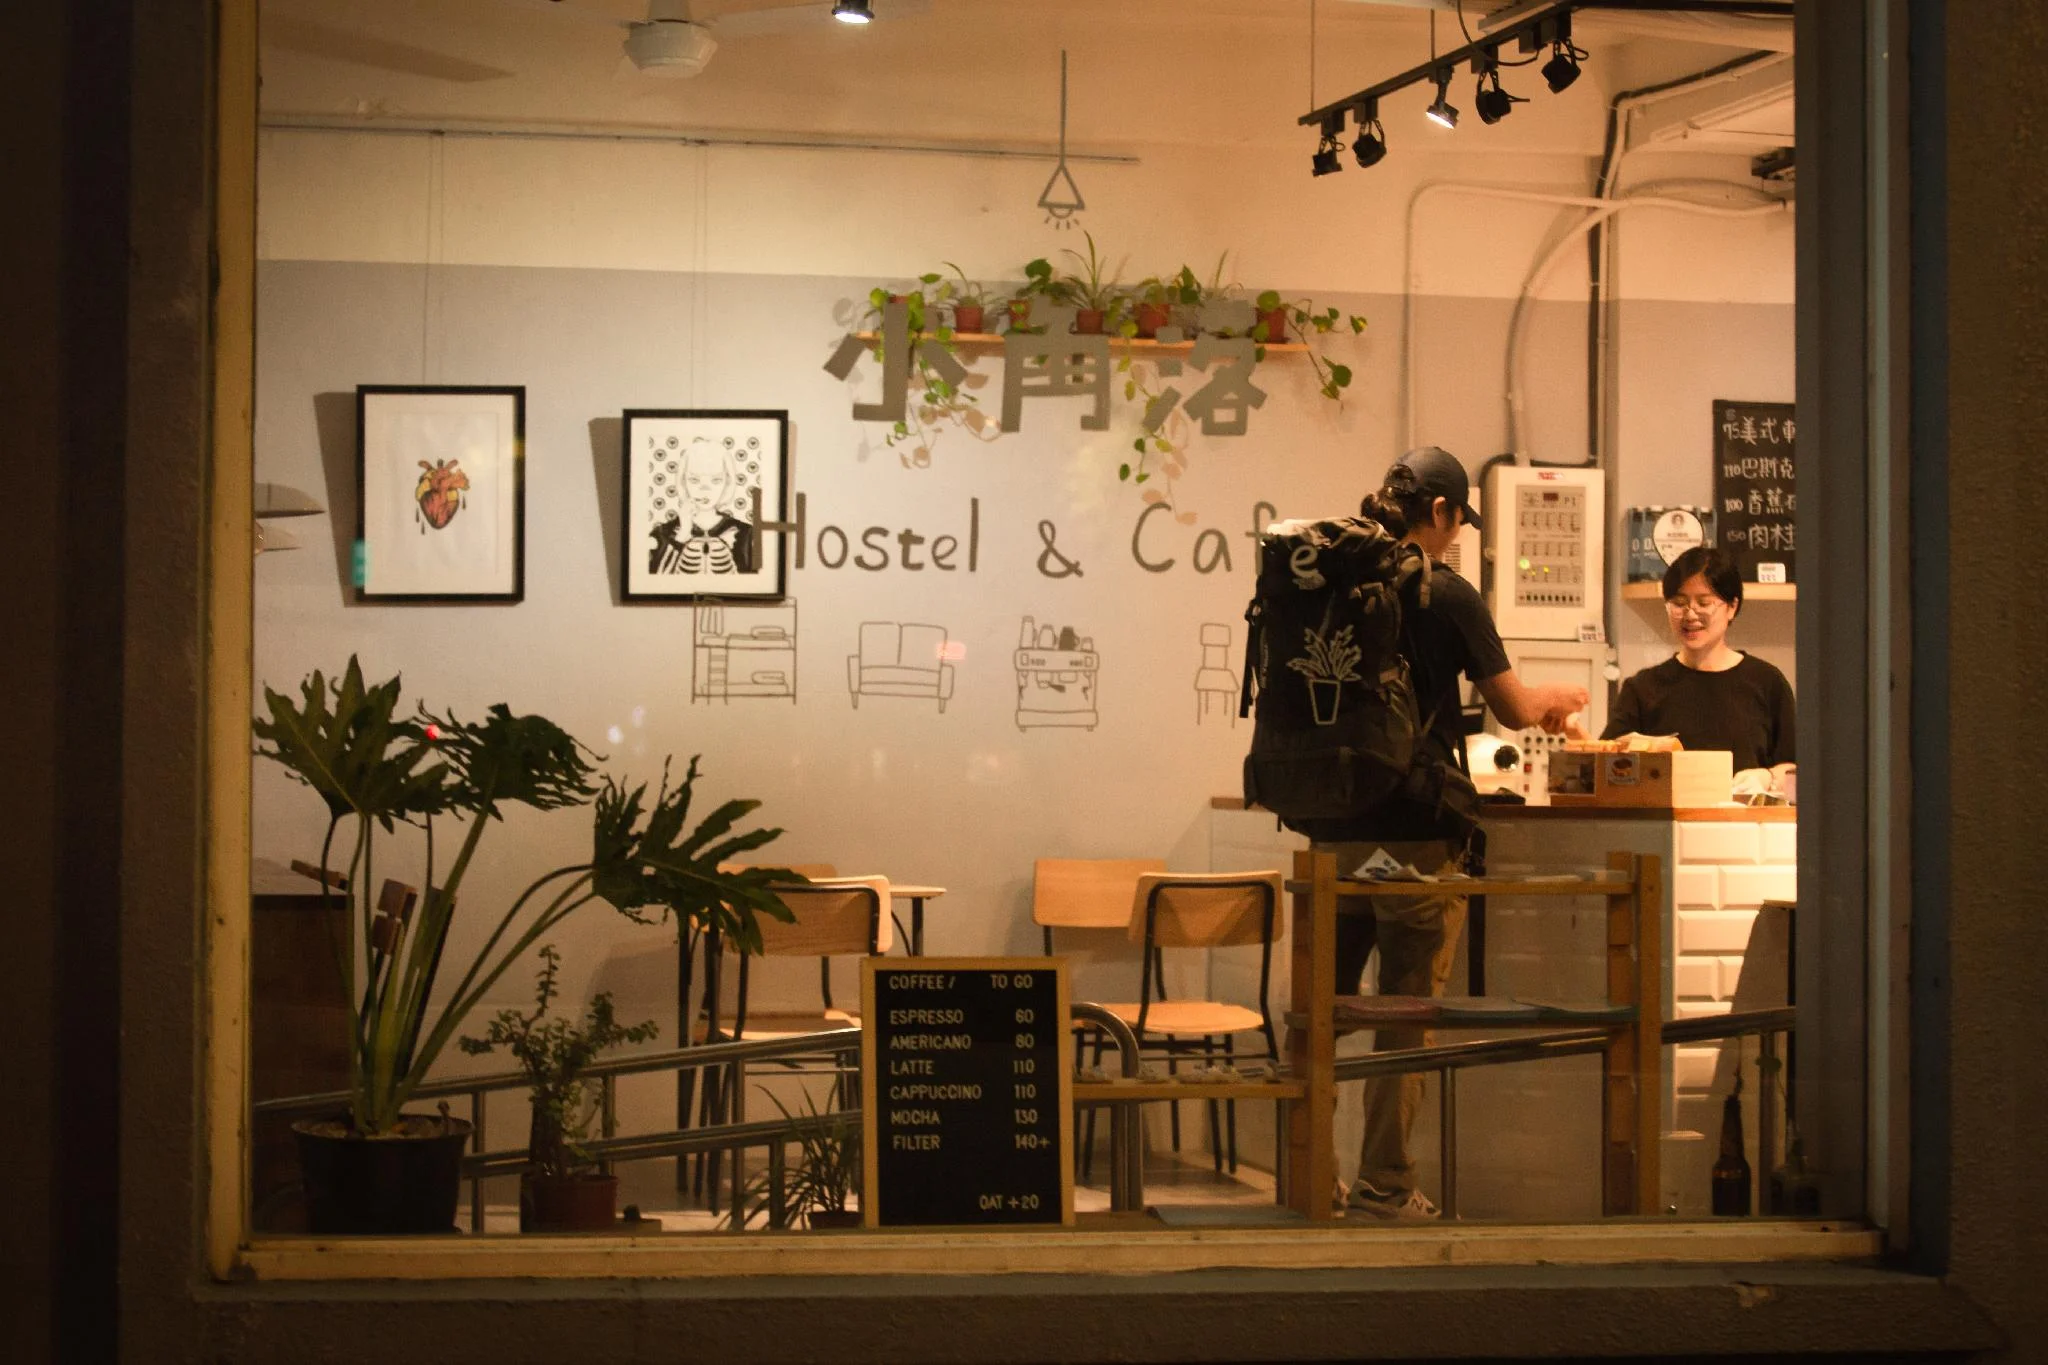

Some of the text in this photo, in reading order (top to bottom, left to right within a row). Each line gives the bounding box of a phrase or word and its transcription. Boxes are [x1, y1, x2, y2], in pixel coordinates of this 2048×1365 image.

[823, 299, 1267, 436] 小角落
[751, 487, 1320, 579] Hostel & Cafe
[889, 974, 945, 990] COFFEE
[990, 974, 1008, 989] TO
[1013, 974, 1033, 989] GO
[890, 1008, 1034, 1025] ESPRESSO 60
[890, 1033, 1034, 1050] AMERICANO 80
[890, 1059, 1035, 1075] LATTE 110
[890, 1084, 1037, 1100] CAPPUCCINO 110
[890, 1109, 1038, 1125] MOCHA 130
[892, 1134, 941, 1150] FILTER
[979, 1195, 1003, 1211] OAT
